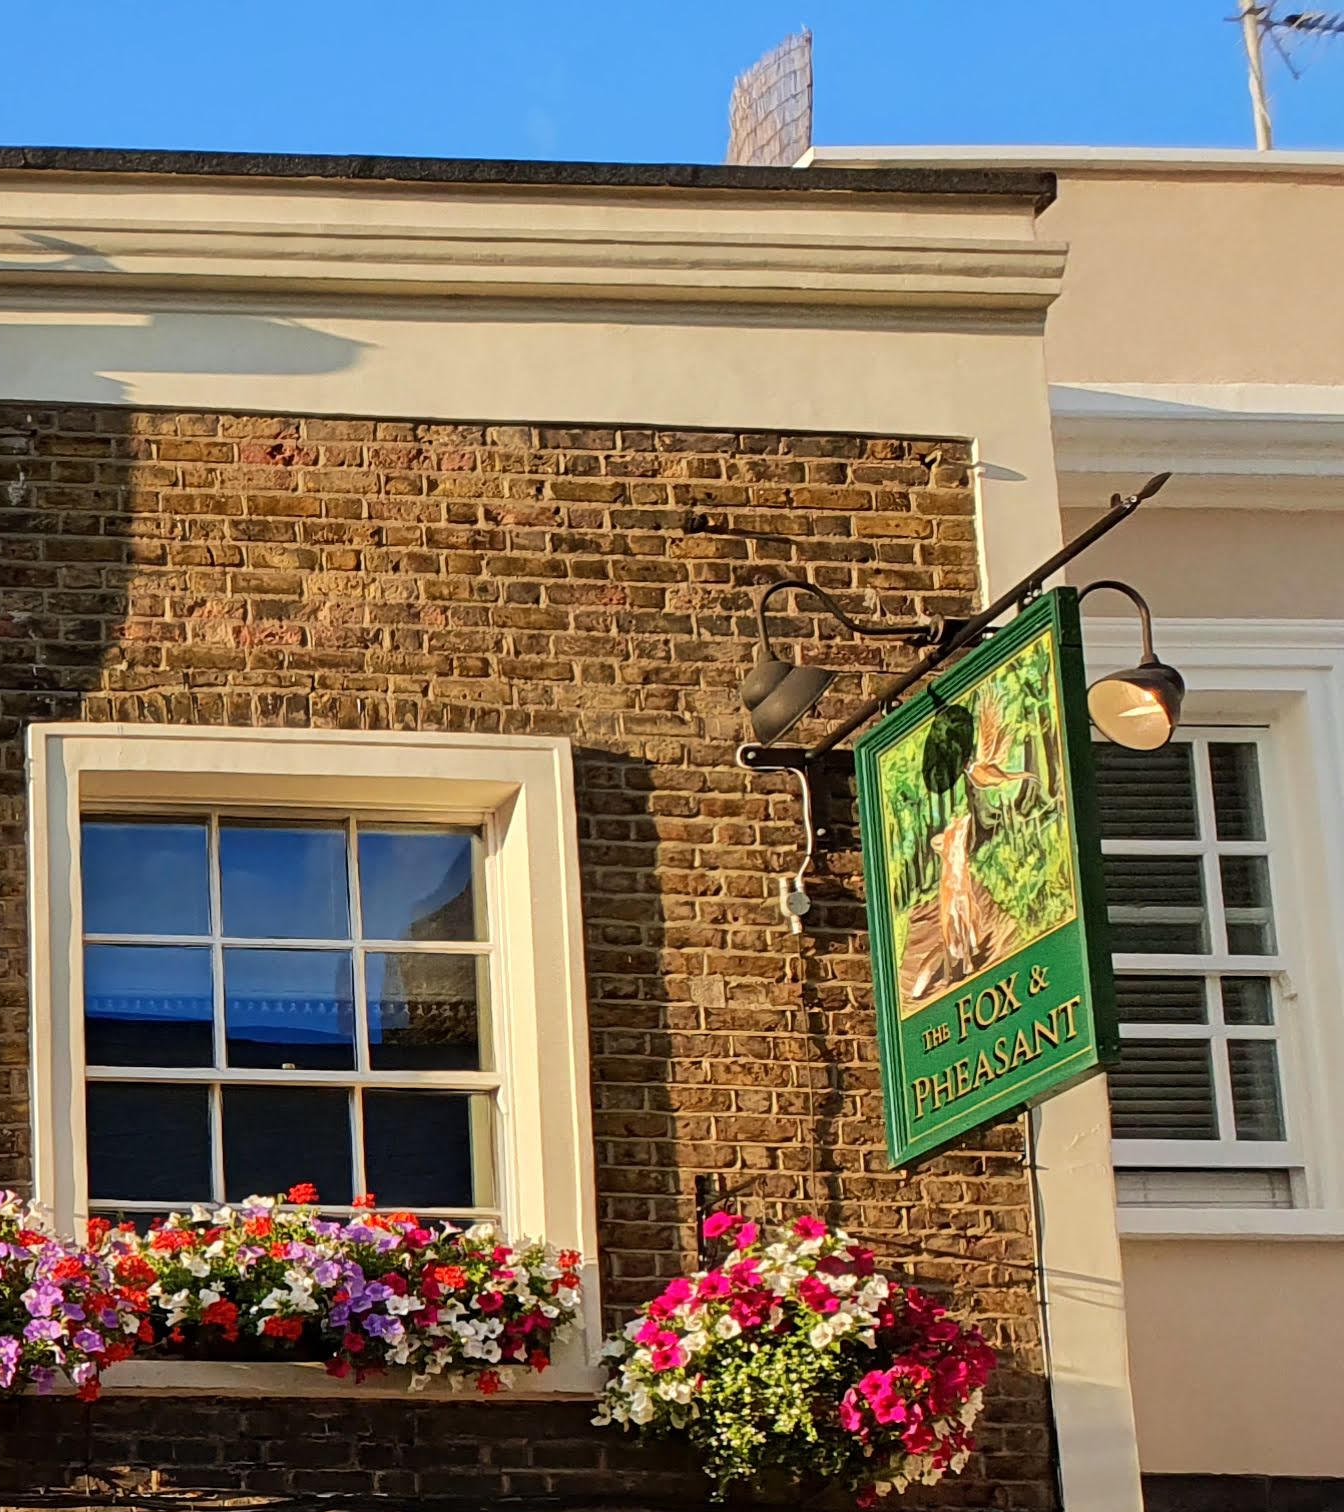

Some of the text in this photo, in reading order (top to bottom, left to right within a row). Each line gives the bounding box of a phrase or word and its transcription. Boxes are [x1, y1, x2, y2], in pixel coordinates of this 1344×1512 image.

[911, 994, 1081, 1122] PHEASANT
[922, 964, 1050, 1053] THE FOX &
